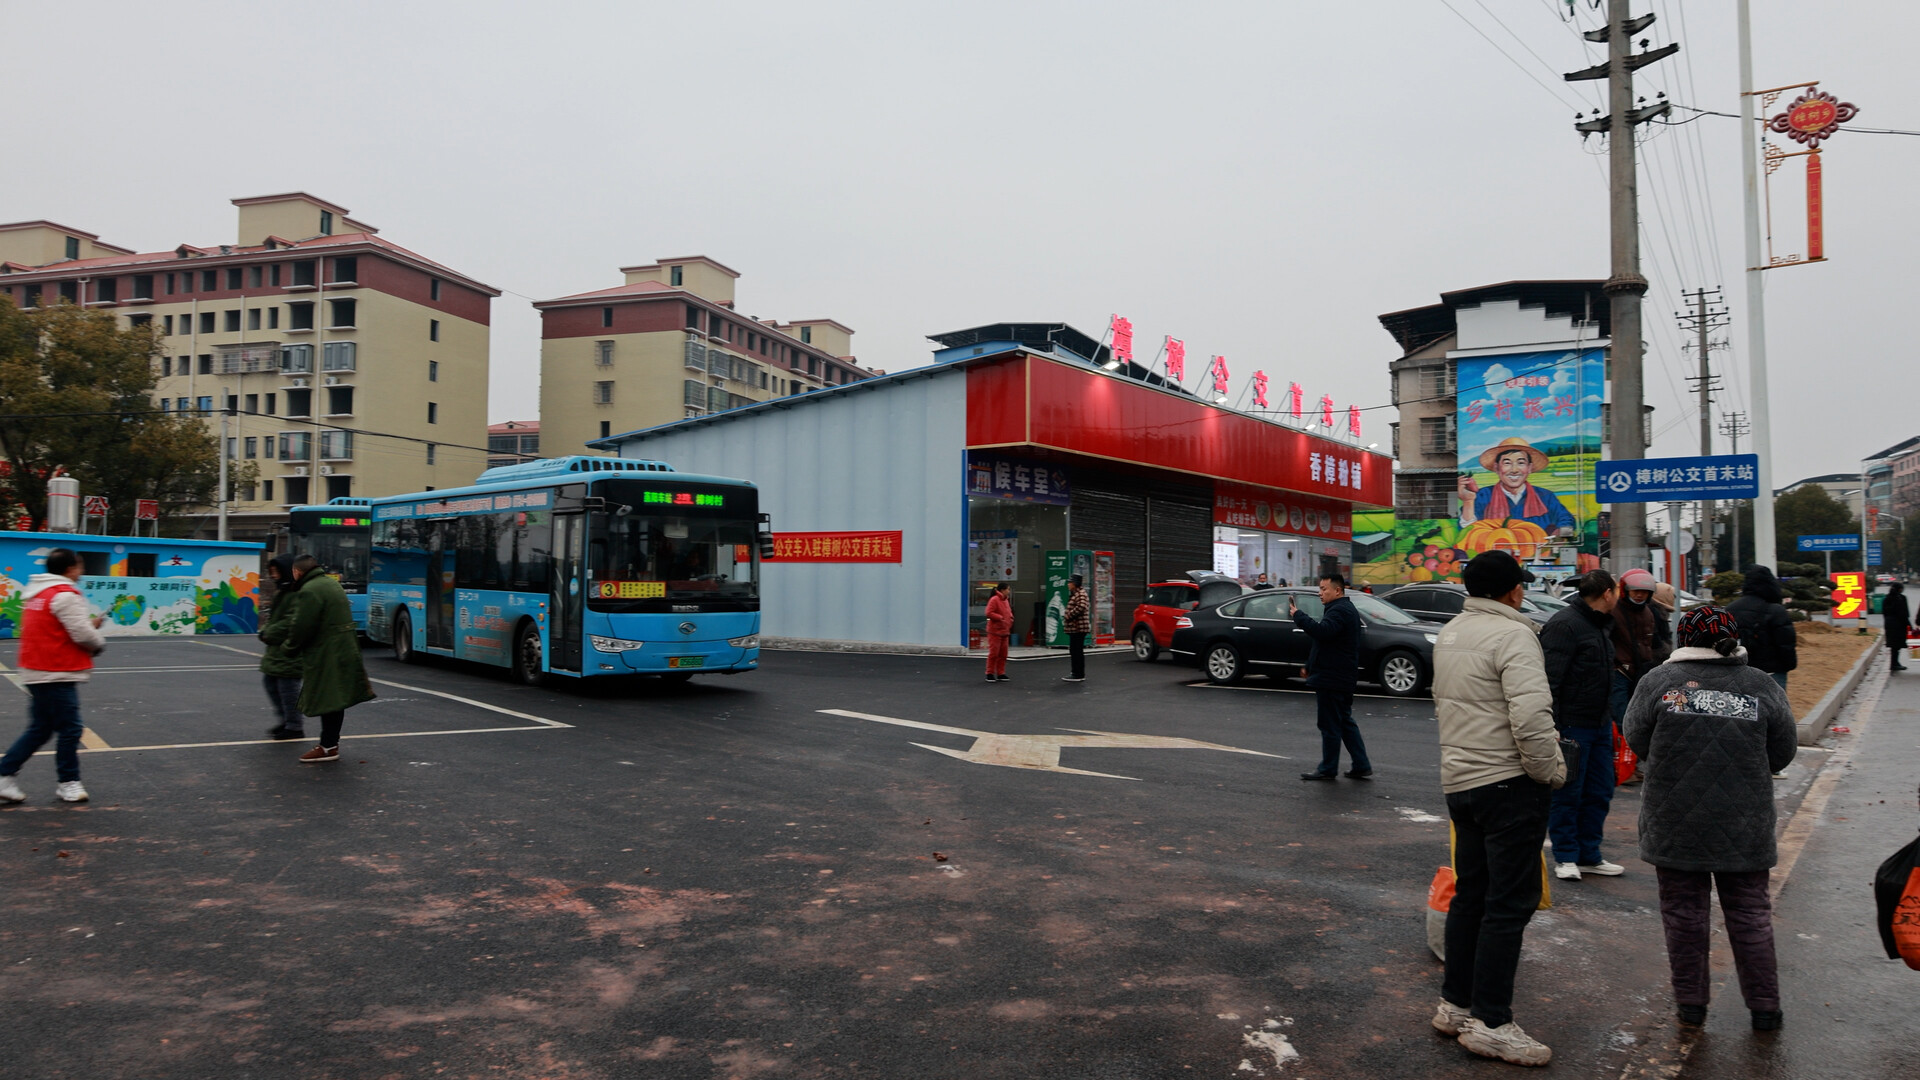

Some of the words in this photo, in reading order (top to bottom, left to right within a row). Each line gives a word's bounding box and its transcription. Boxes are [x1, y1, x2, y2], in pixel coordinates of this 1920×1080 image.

[1795, 110, 1831, 123] 樟树乡
[1110, 313, 1362, 438] 樟树公交首末站
[1466, 394, 1576, 424] 乡村振兴
[995, 461, 1049, 495] 候车室
[1310, 452, 1362, 491] 香樟粉铺
[1636, 464, 1754, 485] 樟树公交首末站
[84, 496, 159, 520] 公厕
[775, 537, 893, 558] 公交车入驻樟树公交首末站
[170, 554, 183, 566] 女
[85, 580, 128, 591] 爱护环境
[149, 582, 191, 592] 文明同行
[604, 584, 613, 597] 3
